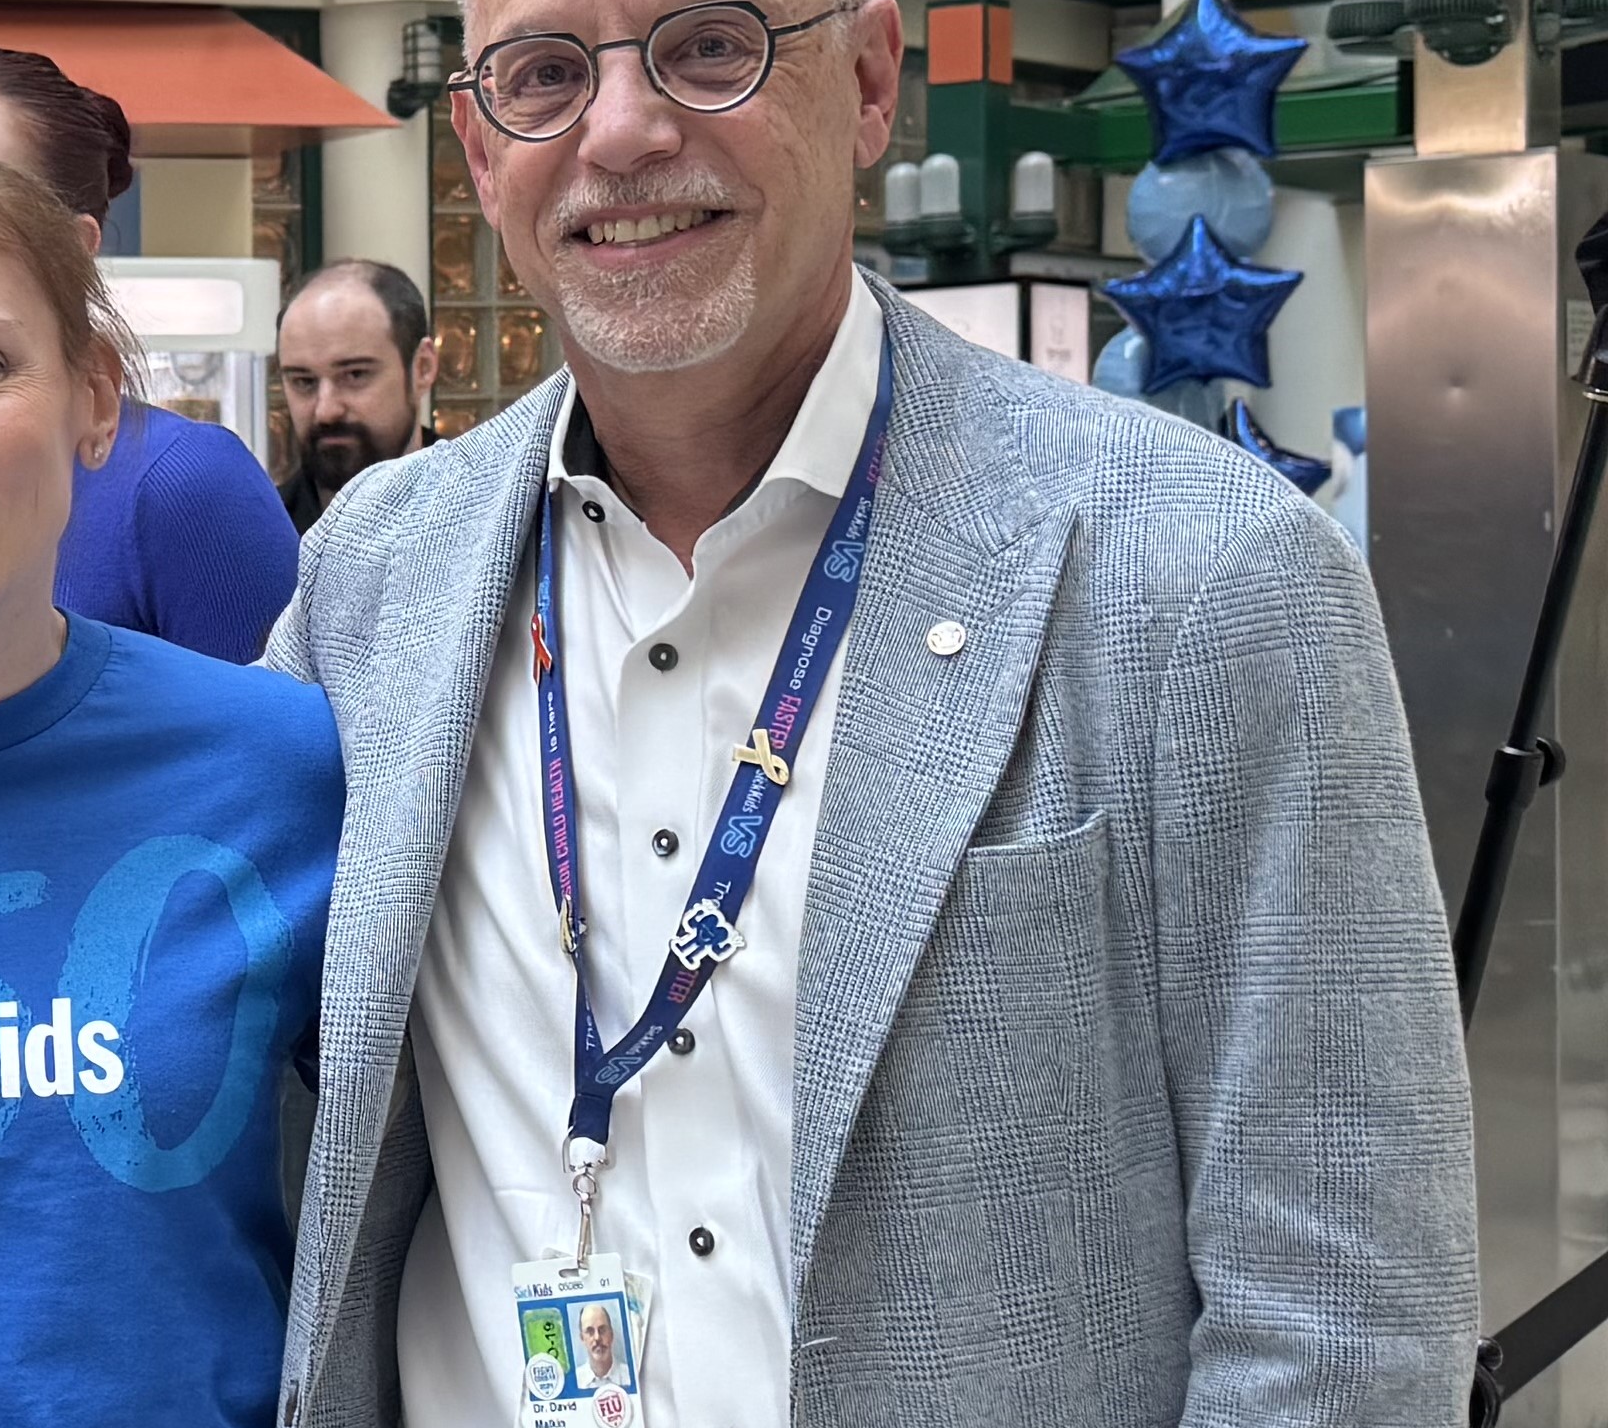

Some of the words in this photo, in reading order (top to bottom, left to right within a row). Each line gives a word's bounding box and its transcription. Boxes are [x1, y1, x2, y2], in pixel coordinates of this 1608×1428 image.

[823, 539, 866, 584] VS
[789, 606, 833, 691] Diagnose
[552, 814, 570, 860] CHILD
[719, 814, 764, 859] VS
[594, 1055, 643, 1085] VS
[550, 1402, 577, 1413] David
[599, 1399, 623, 1418] FLU
